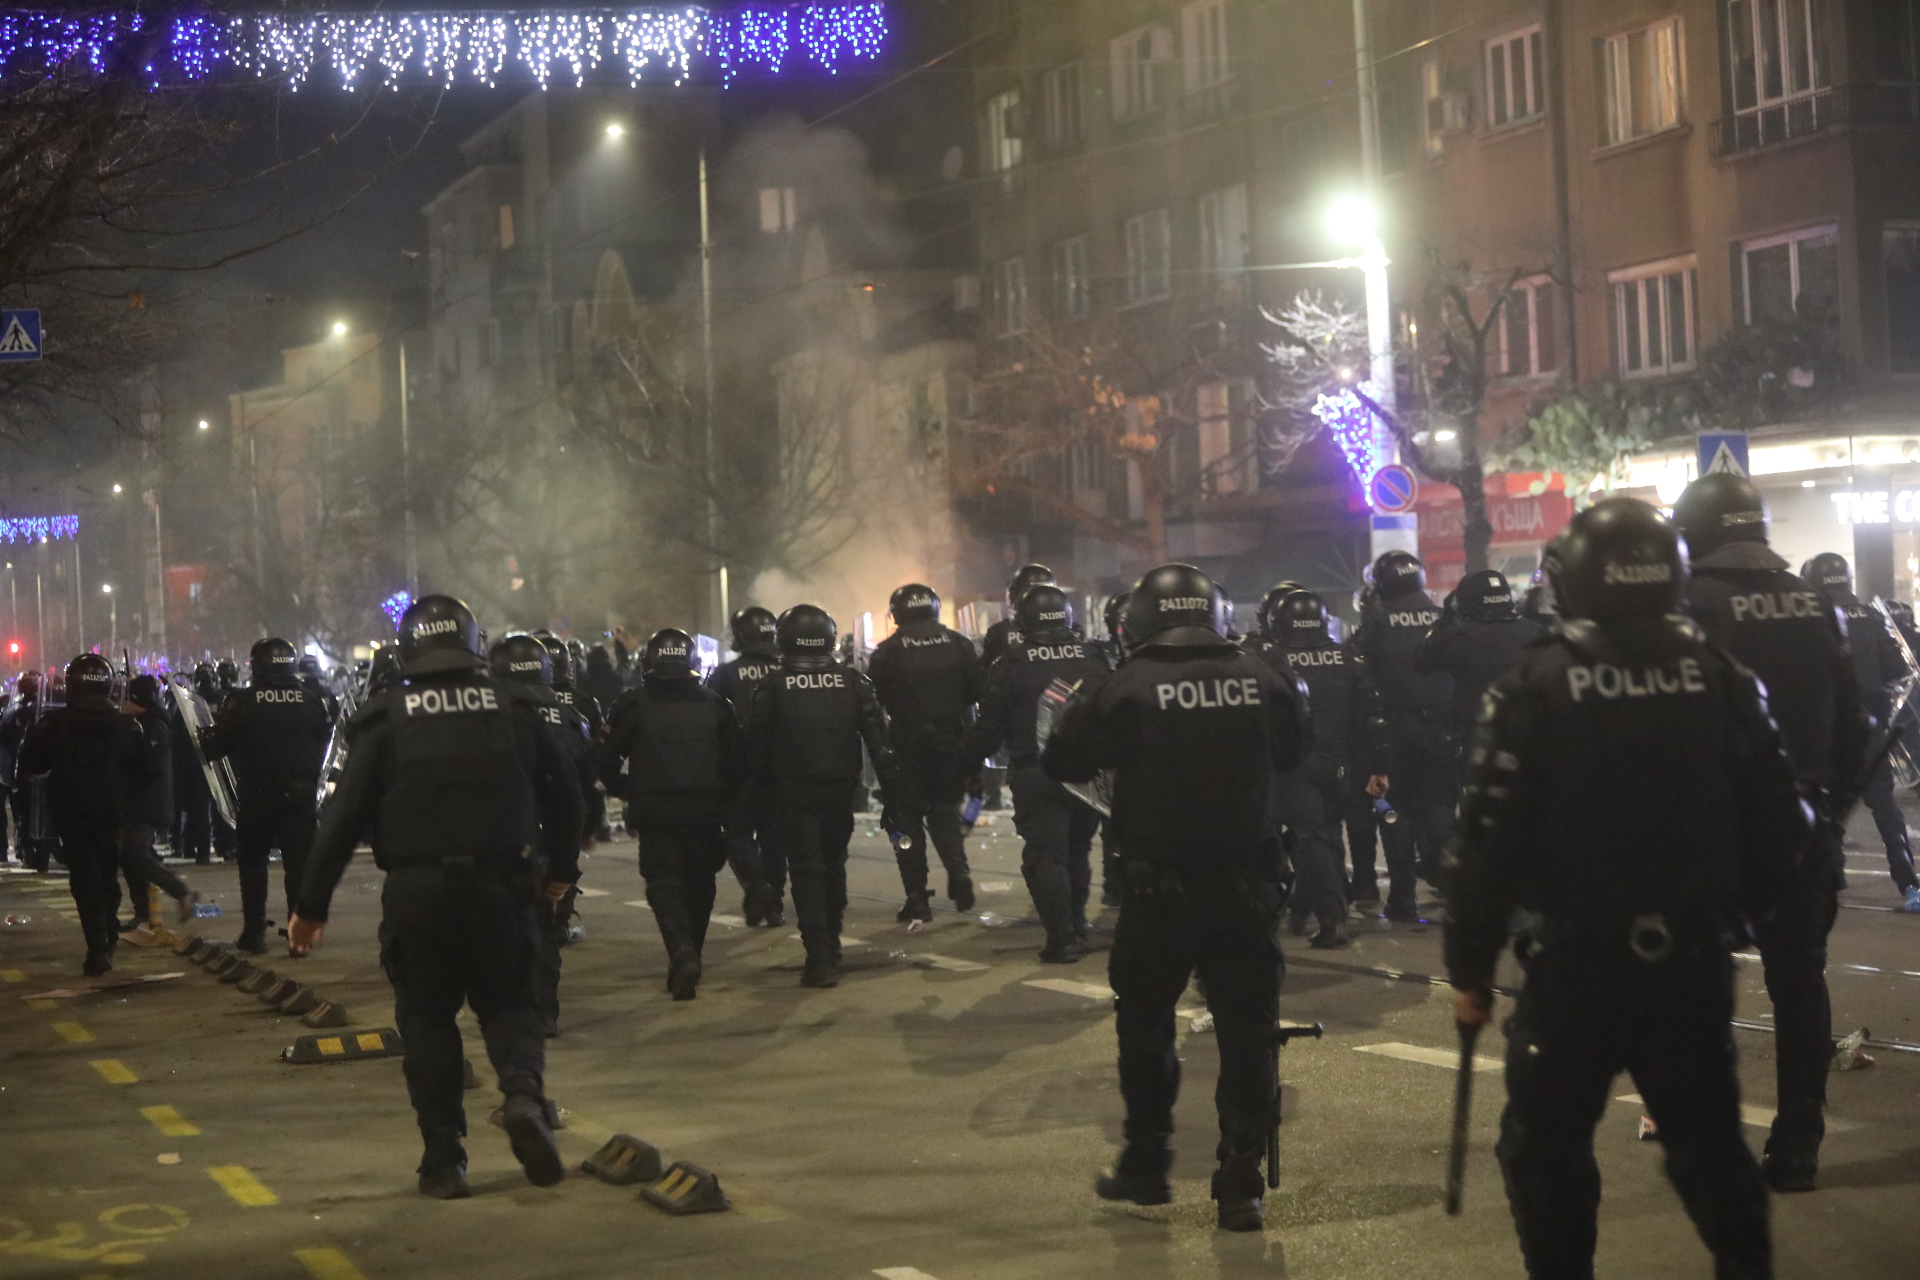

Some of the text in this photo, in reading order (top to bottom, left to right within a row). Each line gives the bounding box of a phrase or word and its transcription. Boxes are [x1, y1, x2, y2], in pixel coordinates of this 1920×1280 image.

[1830, 491, 1889, 524] THE
[1159, 598, 1209, 612] 2411072
[1730, 592, 1823, 621] POLICE
[413, 619, 458, 640] 2411038
[796, 637, 825, 646] 2411033
[1027, 645, 1085, 661] POLICE
[1287, 651, 1344, 667] POLICE
[785, 673, 845, 690] POLICE
[1567, 659, 1706, 702] POLICE
[256, 690, 304, 703] POLICE
[405, 687, 498, 716] POLICE
[1157, 678, 1261, 710] POLICE
